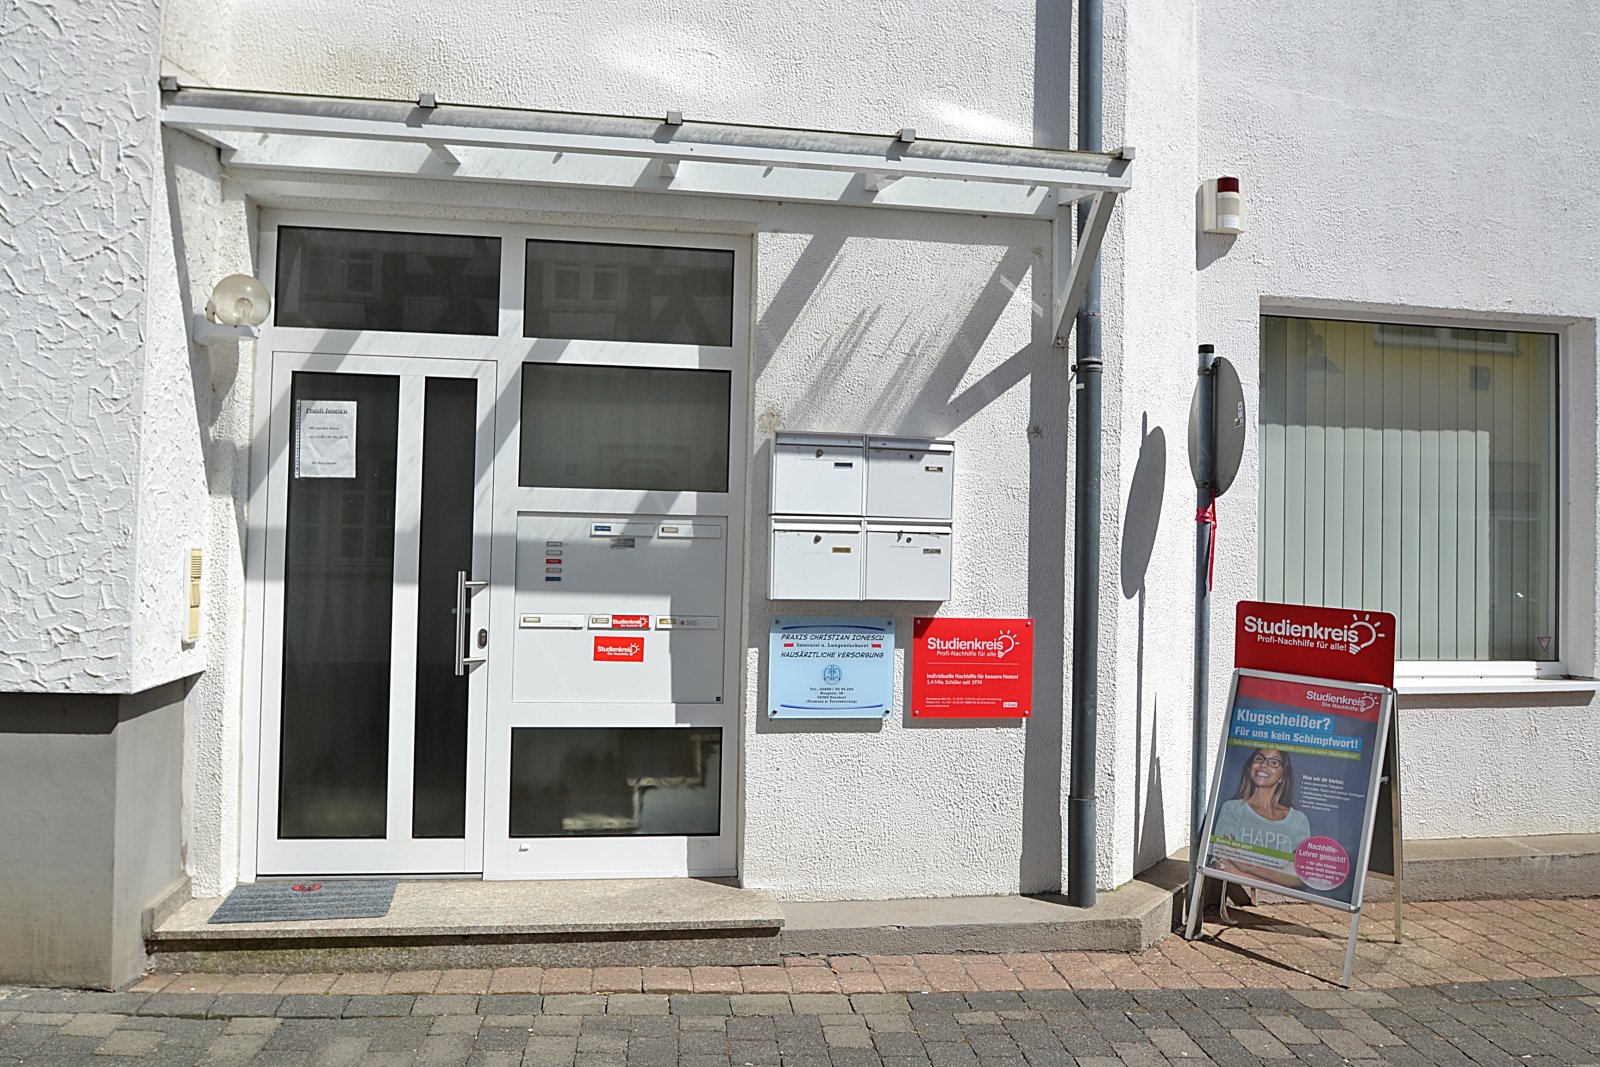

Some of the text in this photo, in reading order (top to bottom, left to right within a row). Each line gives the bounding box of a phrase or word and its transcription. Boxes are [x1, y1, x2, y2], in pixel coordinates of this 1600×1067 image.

[1244, 615, 1359, 643] Studienkreis
[927, 636, 1004, 650] Studienkreis
[1257, 635, 1347, 651] Profi-Nachhilfe für alle!
[1306, 690, 1366, 707] Studienkreis
[1332, 703, 1358, 711] Nachhilfe
[1236, 709, 1331, 730] Klugscheißer?
[1234, 726, 1359, 749] Für uns kein Schimpfwort!
[1241, 826, 1292, 853] HAPPY
[1307, 842, 1338, 853] Nachhilfe-
[1299, 849, 1346, 863] Lehrer gesucht!
